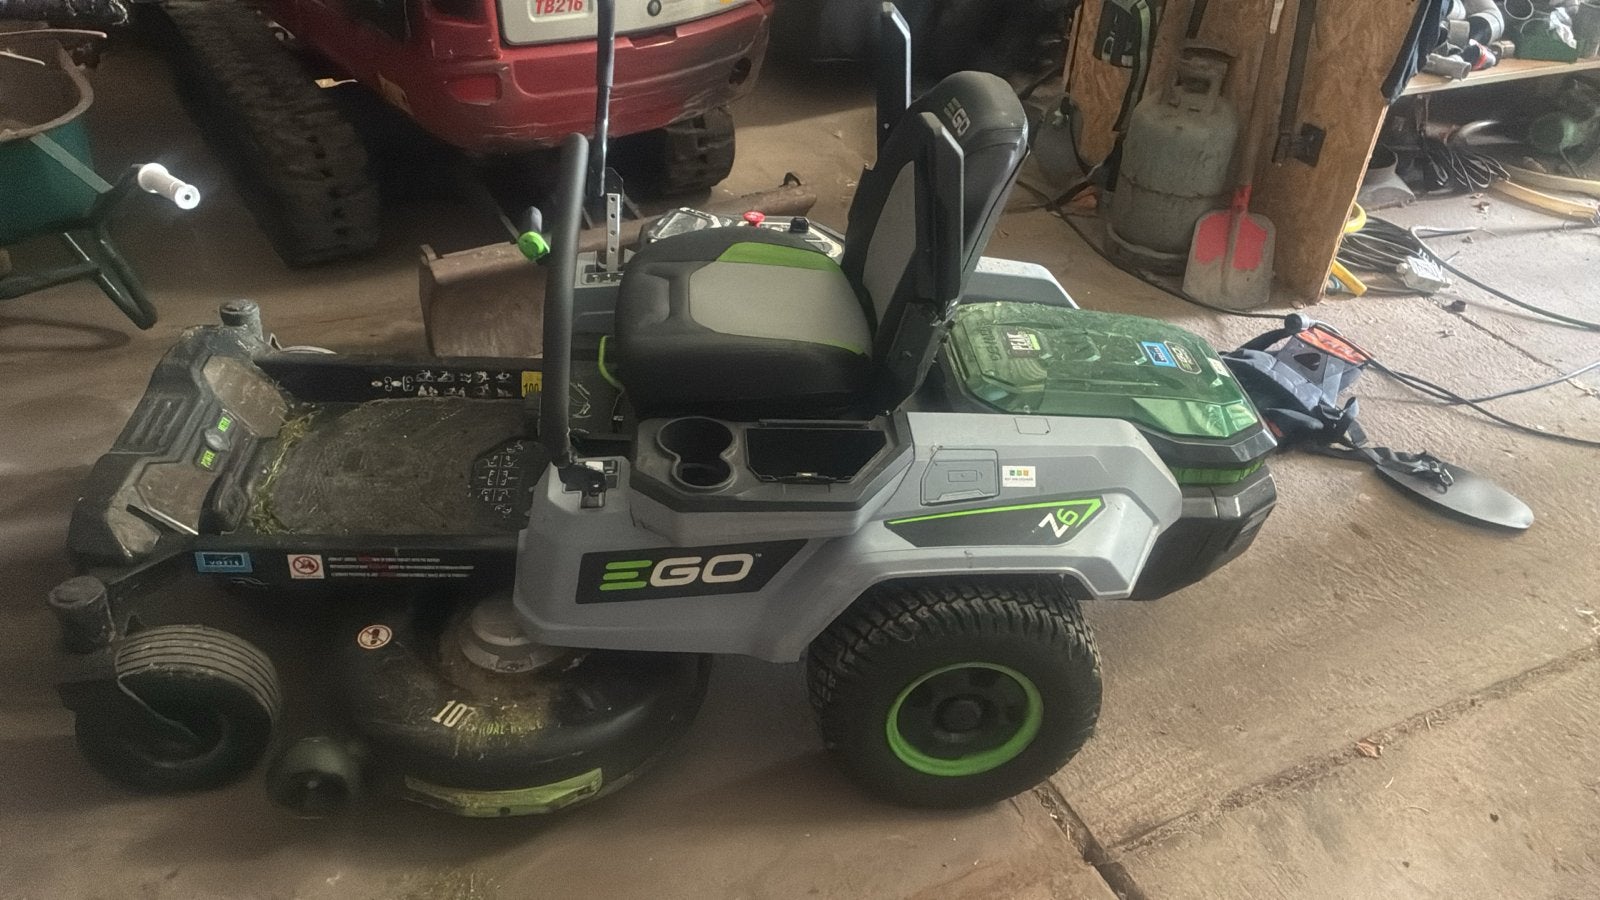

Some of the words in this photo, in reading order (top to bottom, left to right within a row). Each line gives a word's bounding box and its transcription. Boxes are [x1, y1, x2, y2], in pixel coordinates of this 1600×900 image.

[535, 0, 583, 14] TB216
[944, 97, 970, 136] EGO
[1038, 508, 1078, 538] Z6
[600, 553, 754, 591] EGO
